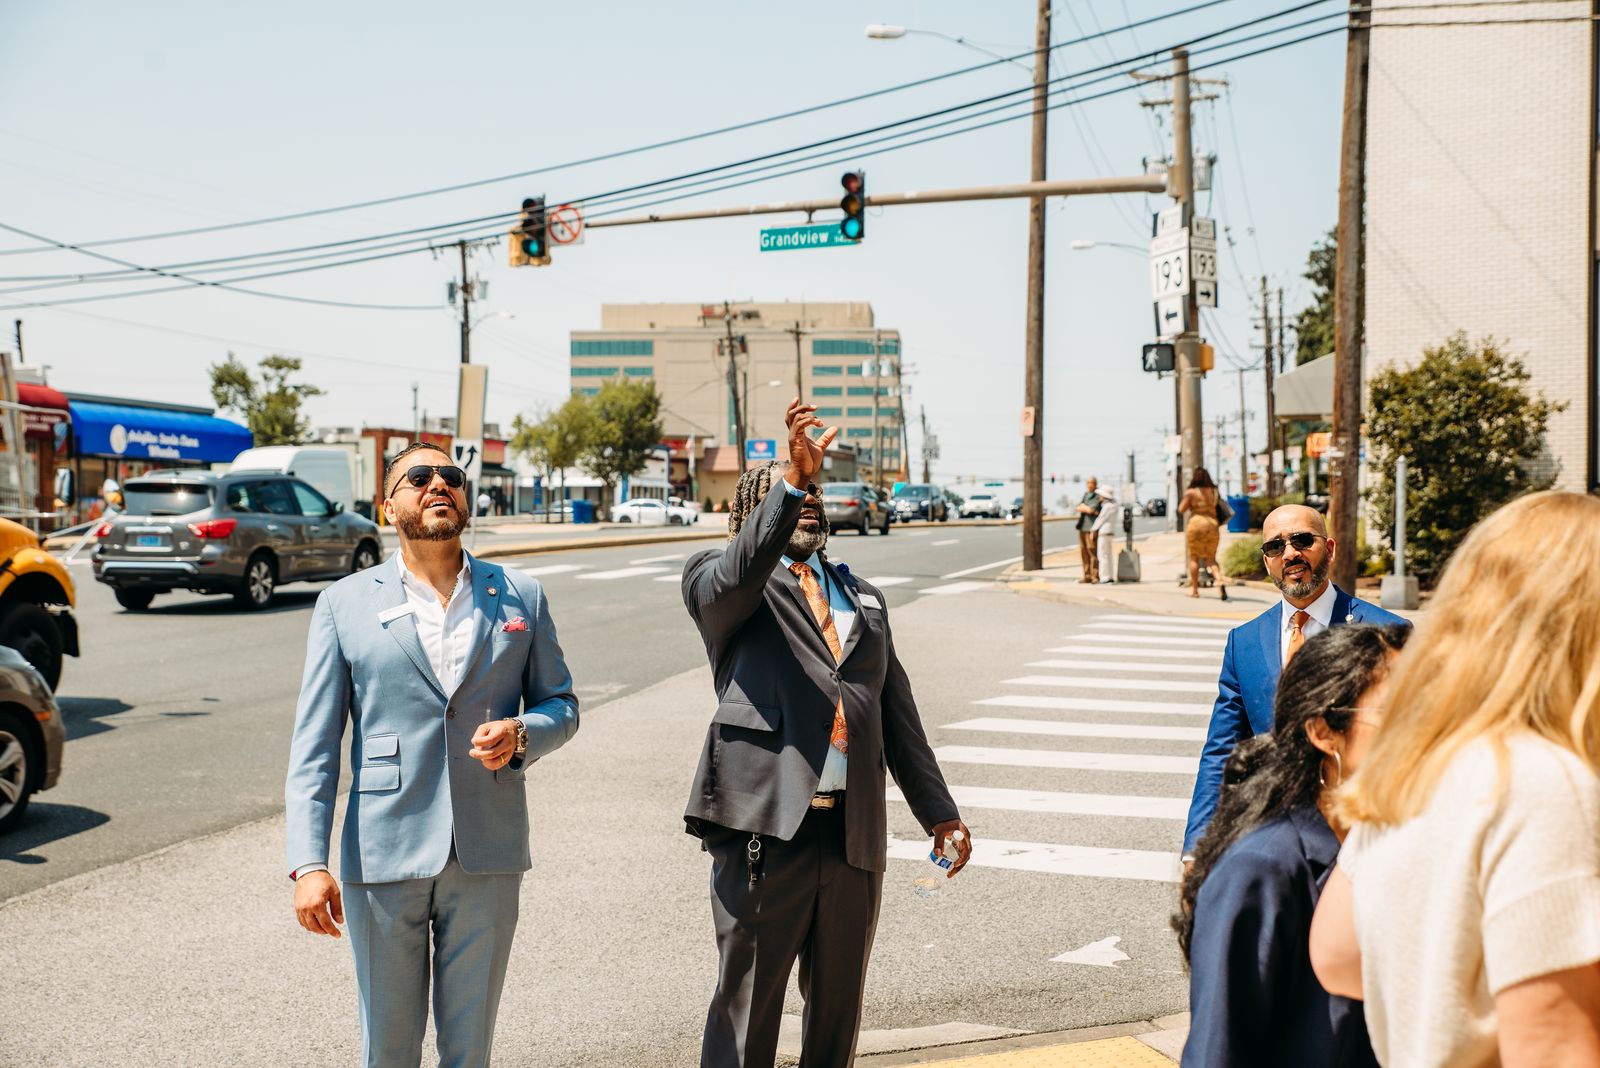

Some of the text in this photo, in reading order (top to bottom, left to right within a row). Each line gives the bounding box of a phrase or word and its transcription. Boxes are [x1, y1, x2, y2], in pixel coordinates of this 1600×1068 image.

[761, 231, 829, 248] Grandview
[1154, 256, 1184, 293] 193
[1194, 254, 1216, 277] 193
